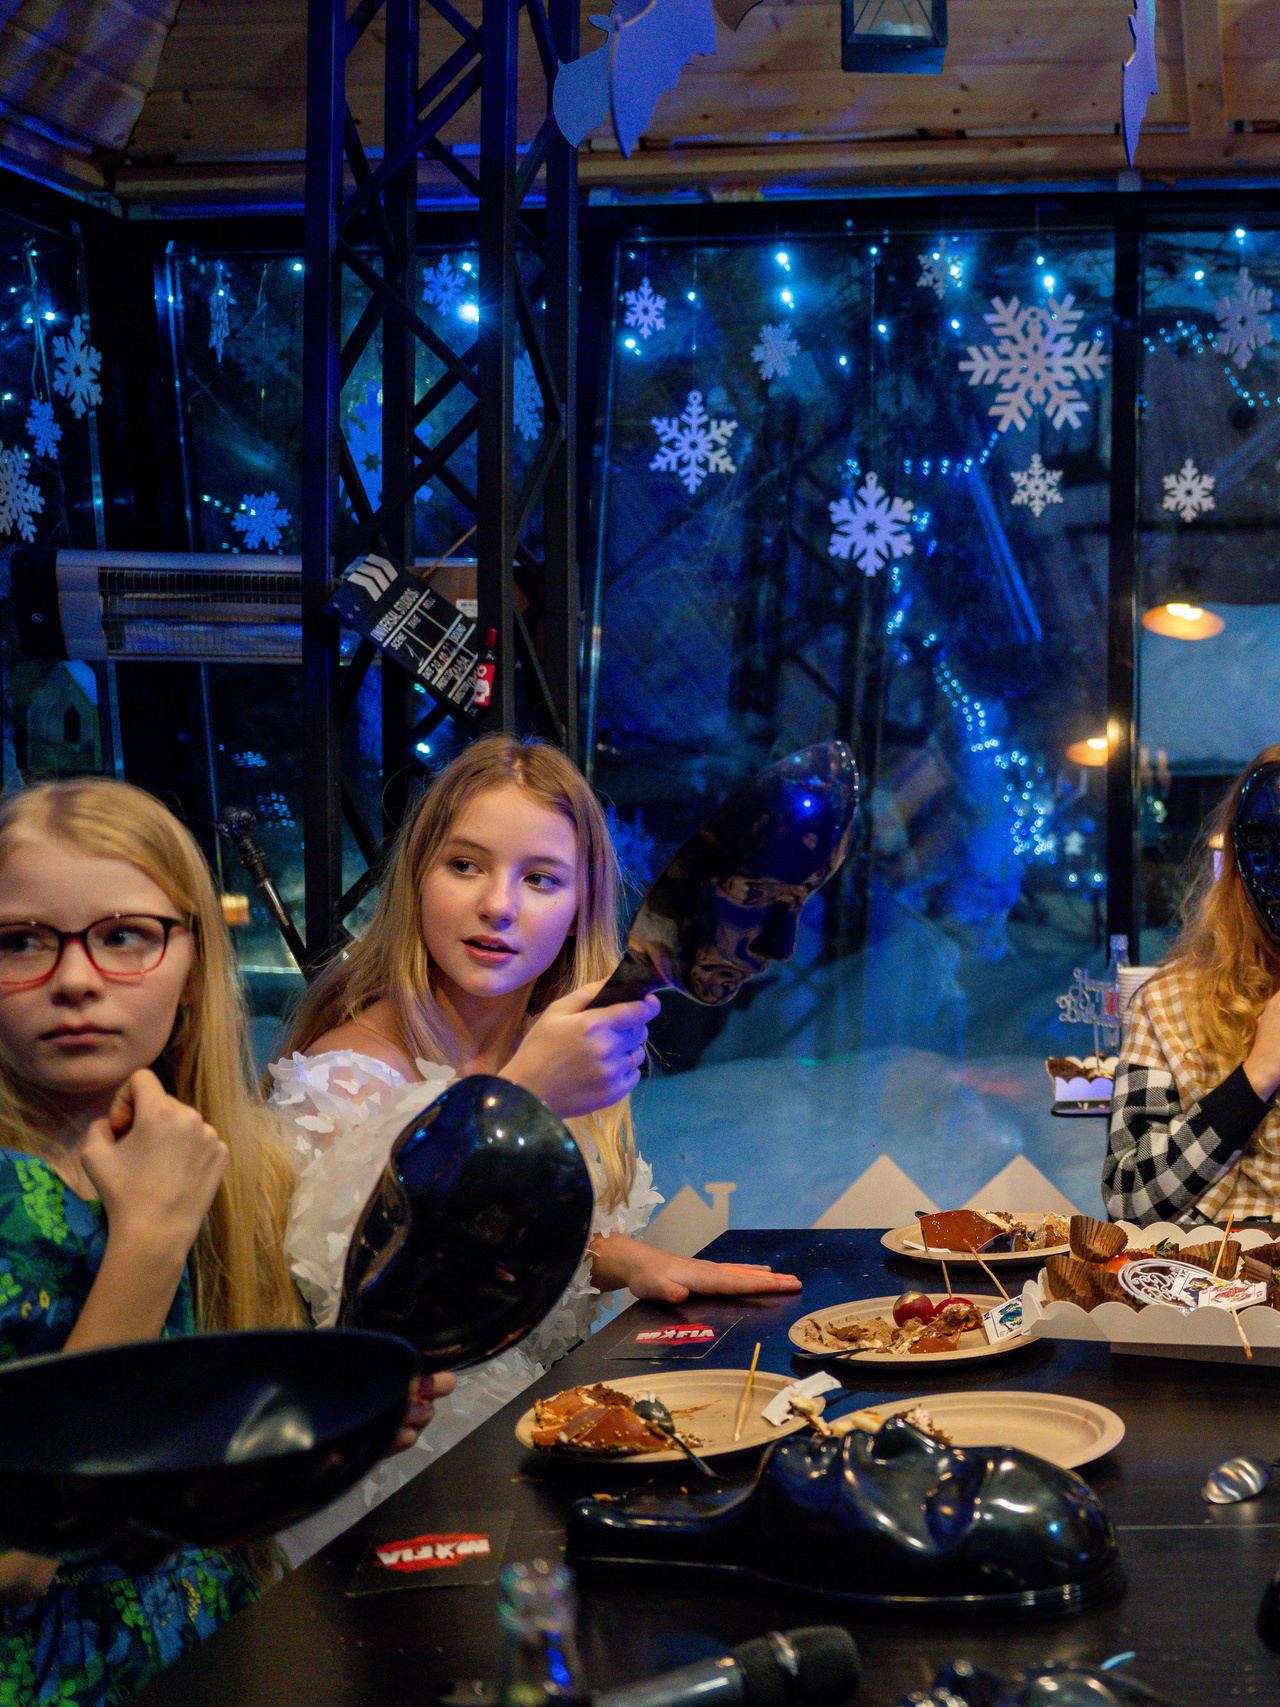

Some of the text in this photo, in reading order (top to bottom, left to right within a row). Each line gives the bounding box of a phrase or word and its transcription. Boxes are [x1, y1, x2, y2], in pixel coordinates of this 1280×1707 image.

[370, 609, 402, 642] UNIVERSAL
[450, 623, 467, 643] SOUND
[391, 632, 407, 650] SCENE
